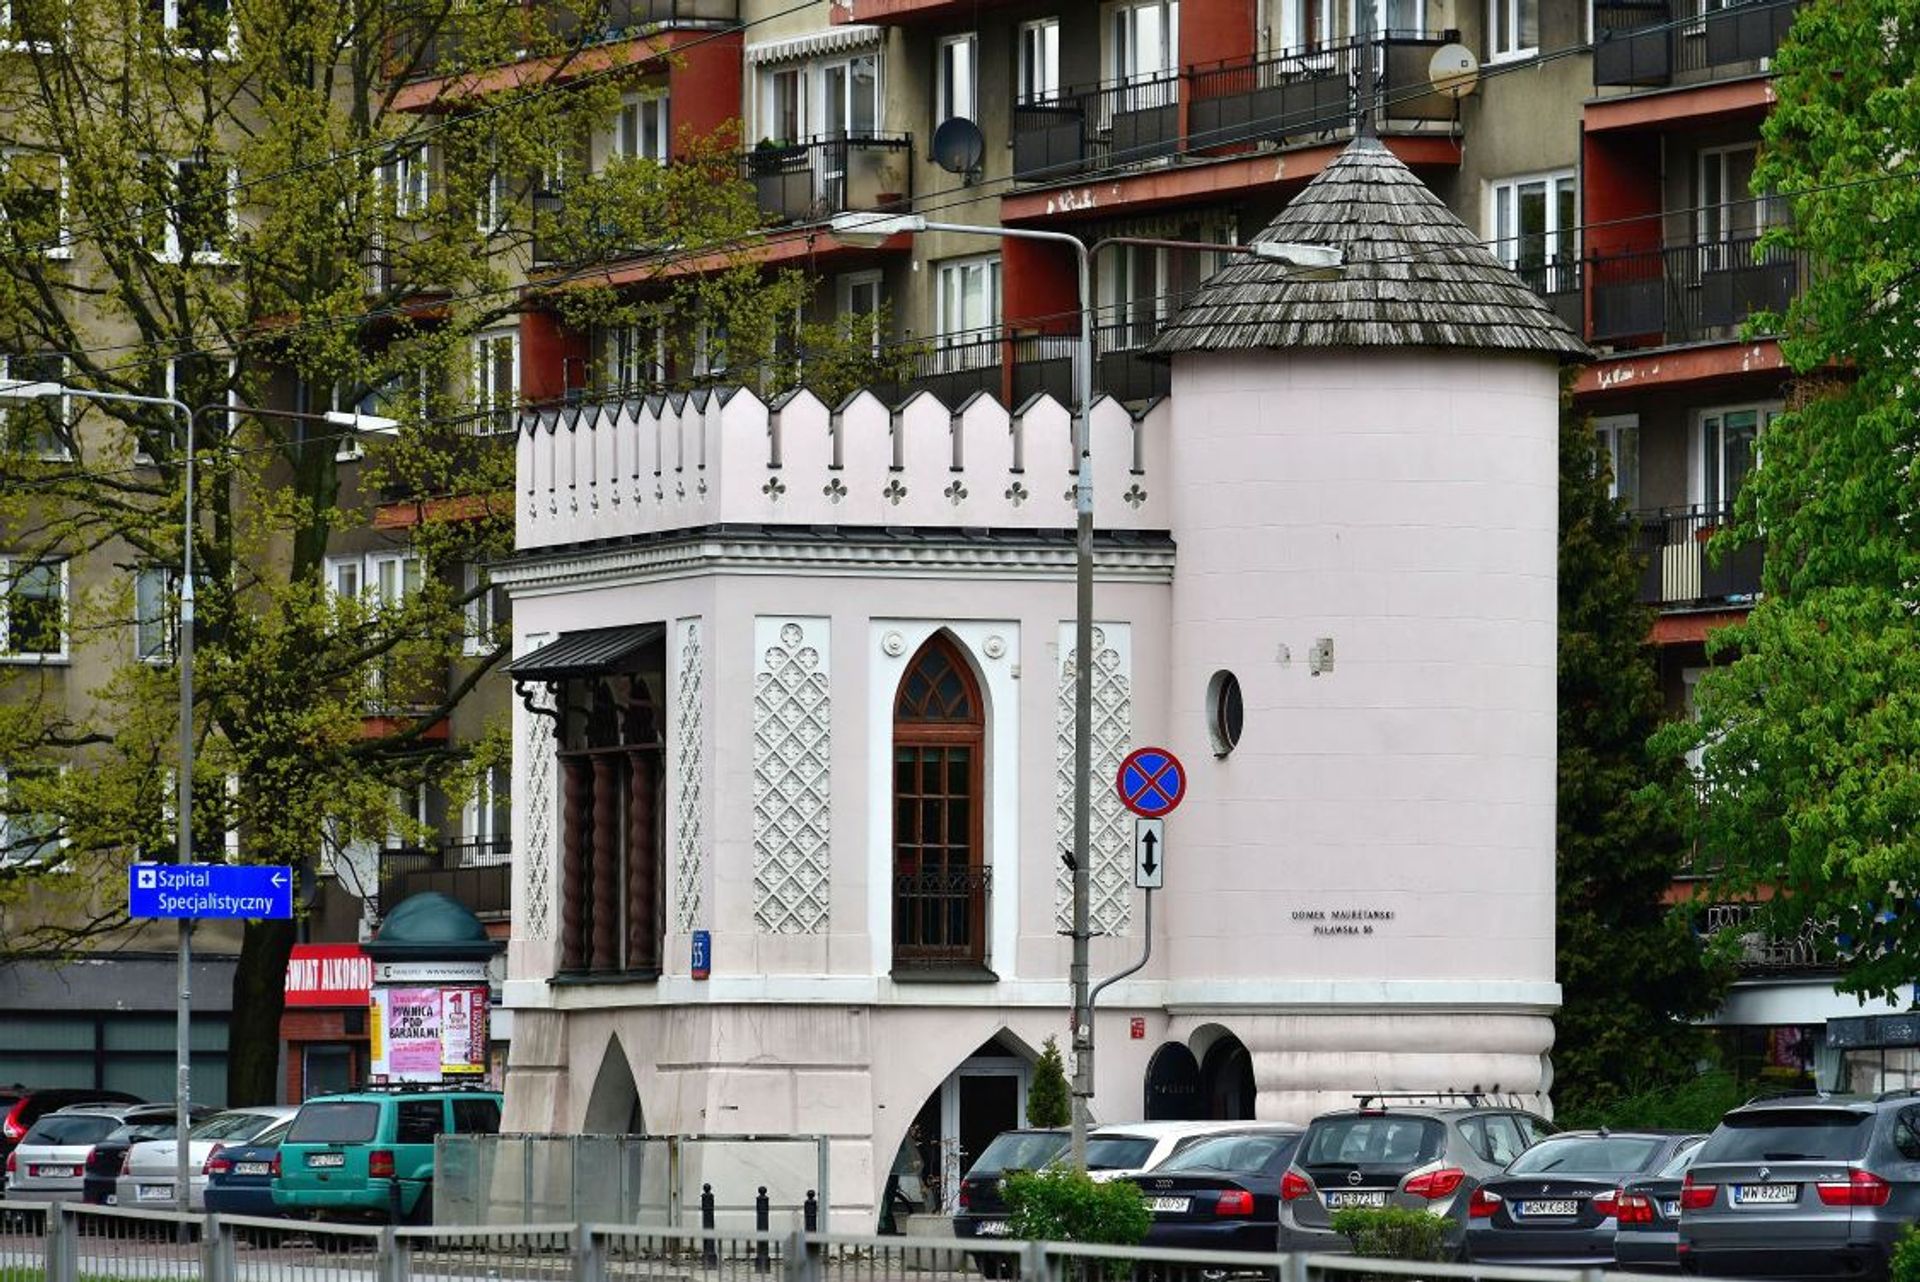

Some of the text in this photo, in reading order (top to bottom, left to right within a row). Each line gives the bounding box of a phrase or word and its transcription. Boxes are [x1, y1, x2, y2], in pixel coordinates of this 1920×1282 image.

[158, 870, 210, 890] Szpital
[158, 892, 273, 914] Specjalistyczny
[1291, 911, 1326, 920] DOMEK
[392, 1006, 433, 1017] PIWNICA
[402, 1018, 423, 1028] POD
[389, 1028, 439, 1039] BARANAMI
